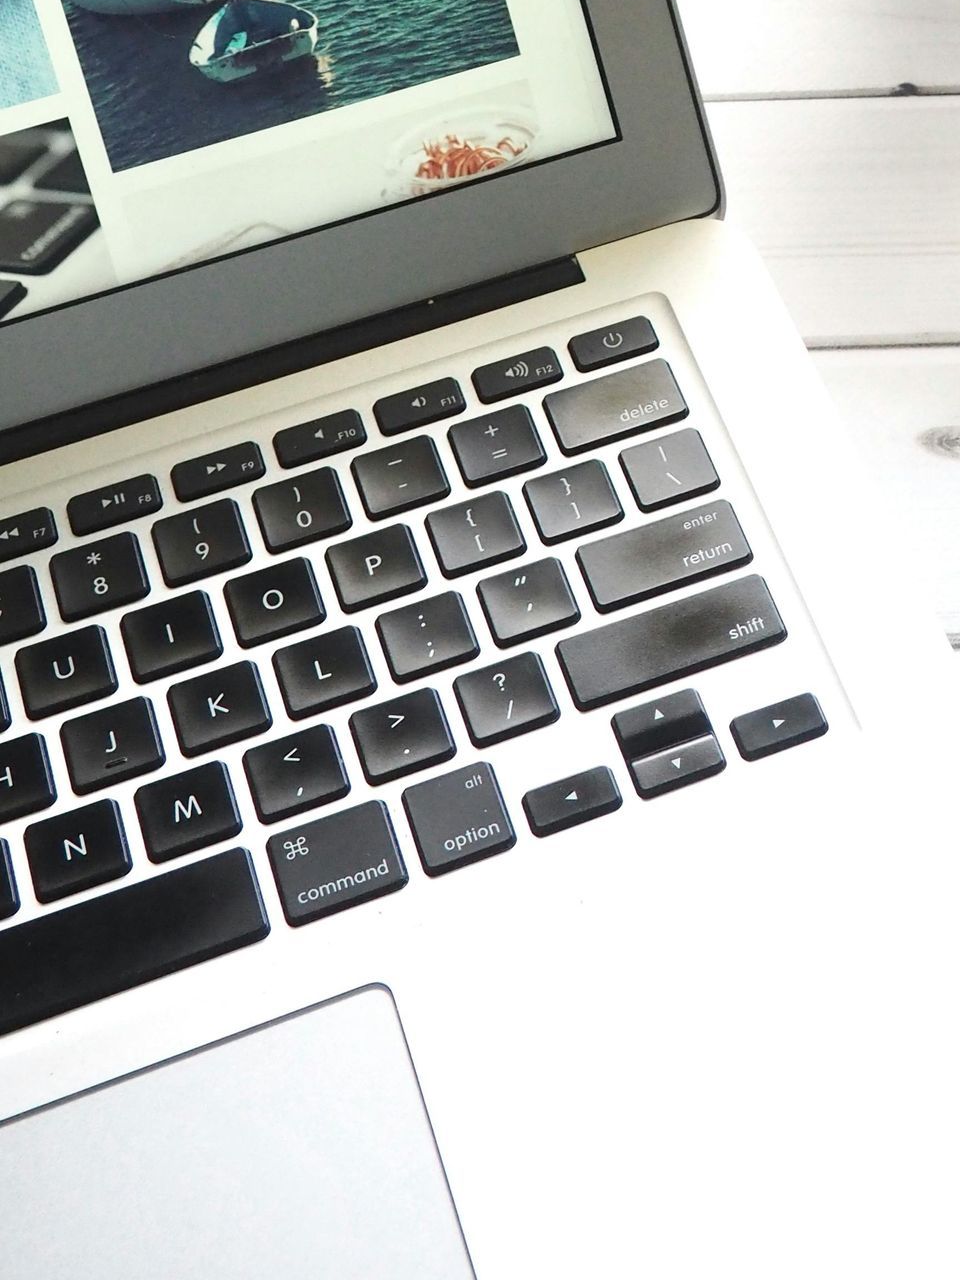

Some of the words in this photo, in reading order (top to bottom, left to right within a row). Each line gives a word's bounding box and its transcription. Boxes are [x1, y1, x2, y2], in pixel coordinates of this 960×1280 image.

[535, 364, 554, 376] F12
[440, 394, 457, 407] F11
[619, 397, 670, 423] delete
[338, 428, 357, 441] F10
[241, 460, 255, 472] F9
[138, 493, 152, 505] F8
[683, 510, 718, 531] enter
[32, 527, 47, 539] F7
[196, 543, 209, 559] 9
[683, 540, 732, 567] return
[366, 556, 381, 575] P
[94, 577, 108, 594] 8
[263, 590, 283, 609] O
[166, 624, 174, 642] I
[728, 617, 766, 640] shift
[53, 656, 74, 679] U
[315, 661, 331, 679] L
[208, 693, 229, 717] K
[106, 731, 116, 752] J
[464, 774, 483, 790] alt
[175, 796, 202, 822] M
[444, 819, 501, 852] option
[64, 834, 86, 860] N
[298, 859, 389, 904] command
